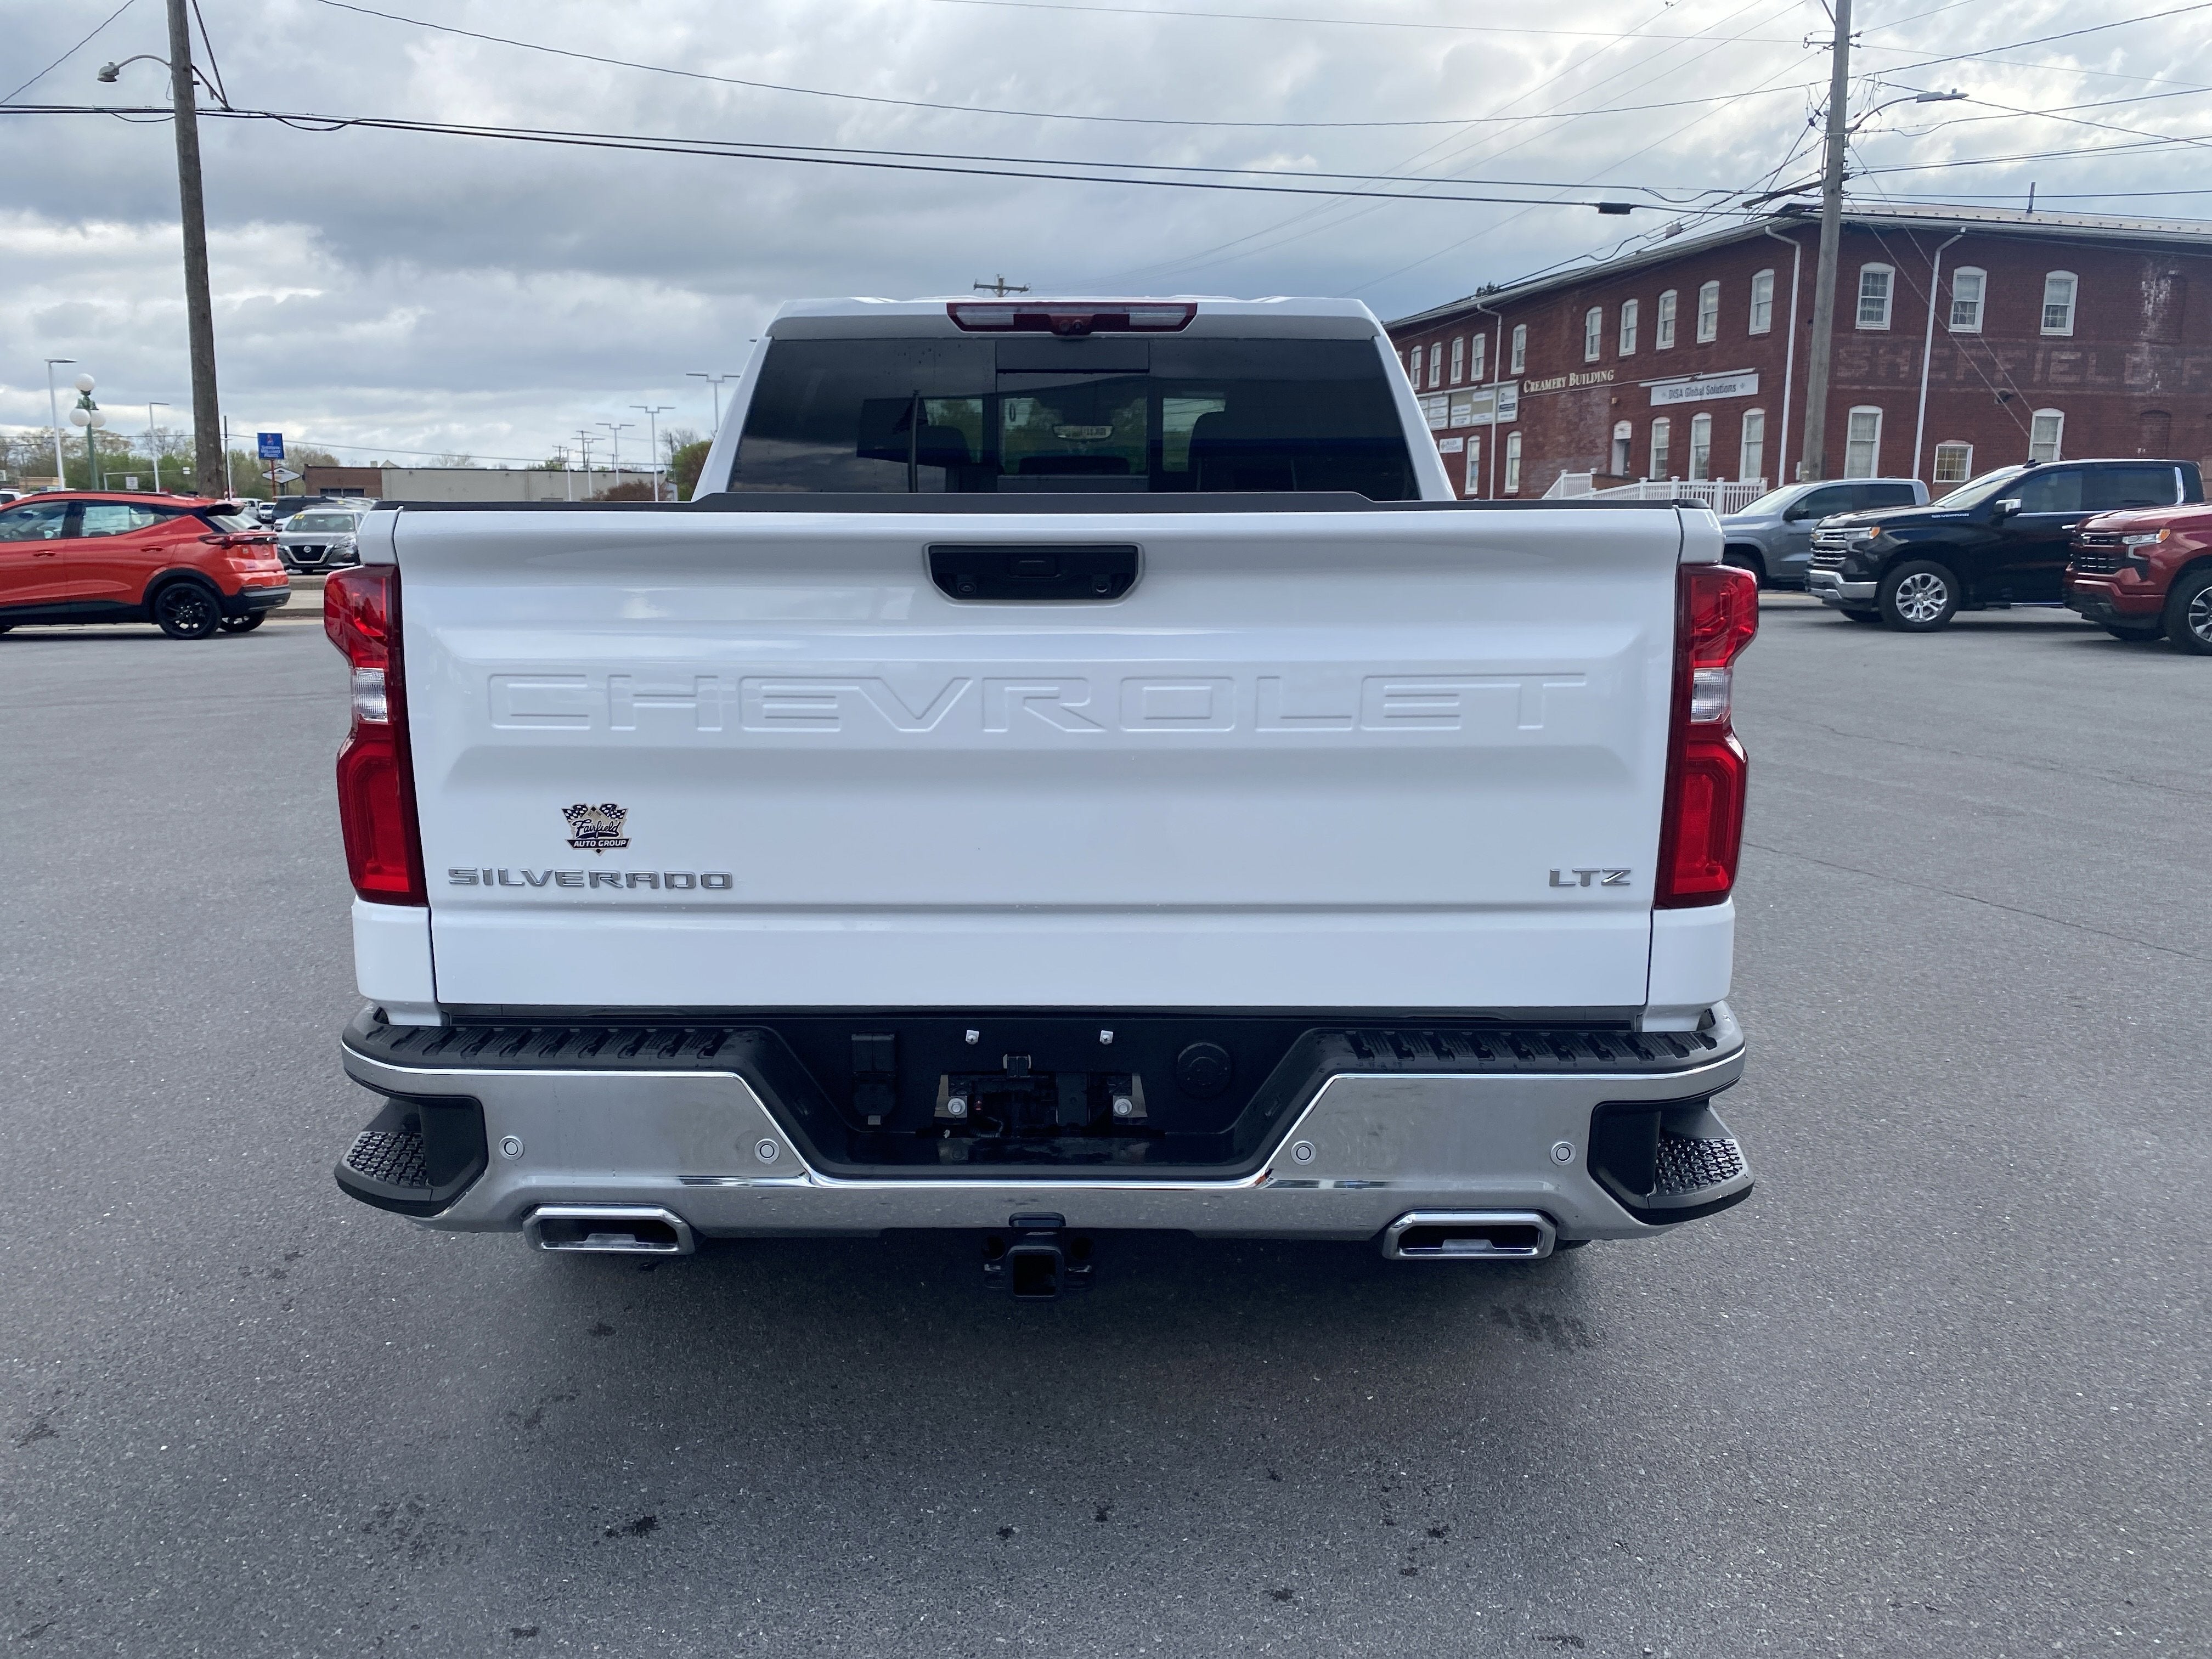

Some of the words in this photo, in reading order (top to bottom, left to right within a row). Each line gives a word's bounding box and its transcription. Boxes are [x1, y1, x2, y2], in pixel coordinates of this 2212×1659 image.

[1685, 386, 1704, 398] Global
[1706, 383, 1737, 396] Solutions
[487, 673, 1587, 733] CHEVROLET
[572, 819, 622, 838] Fairfield
[448, 867, 733, 889] SILVERADO
[1549, 868, 1631, 887] LTZ
